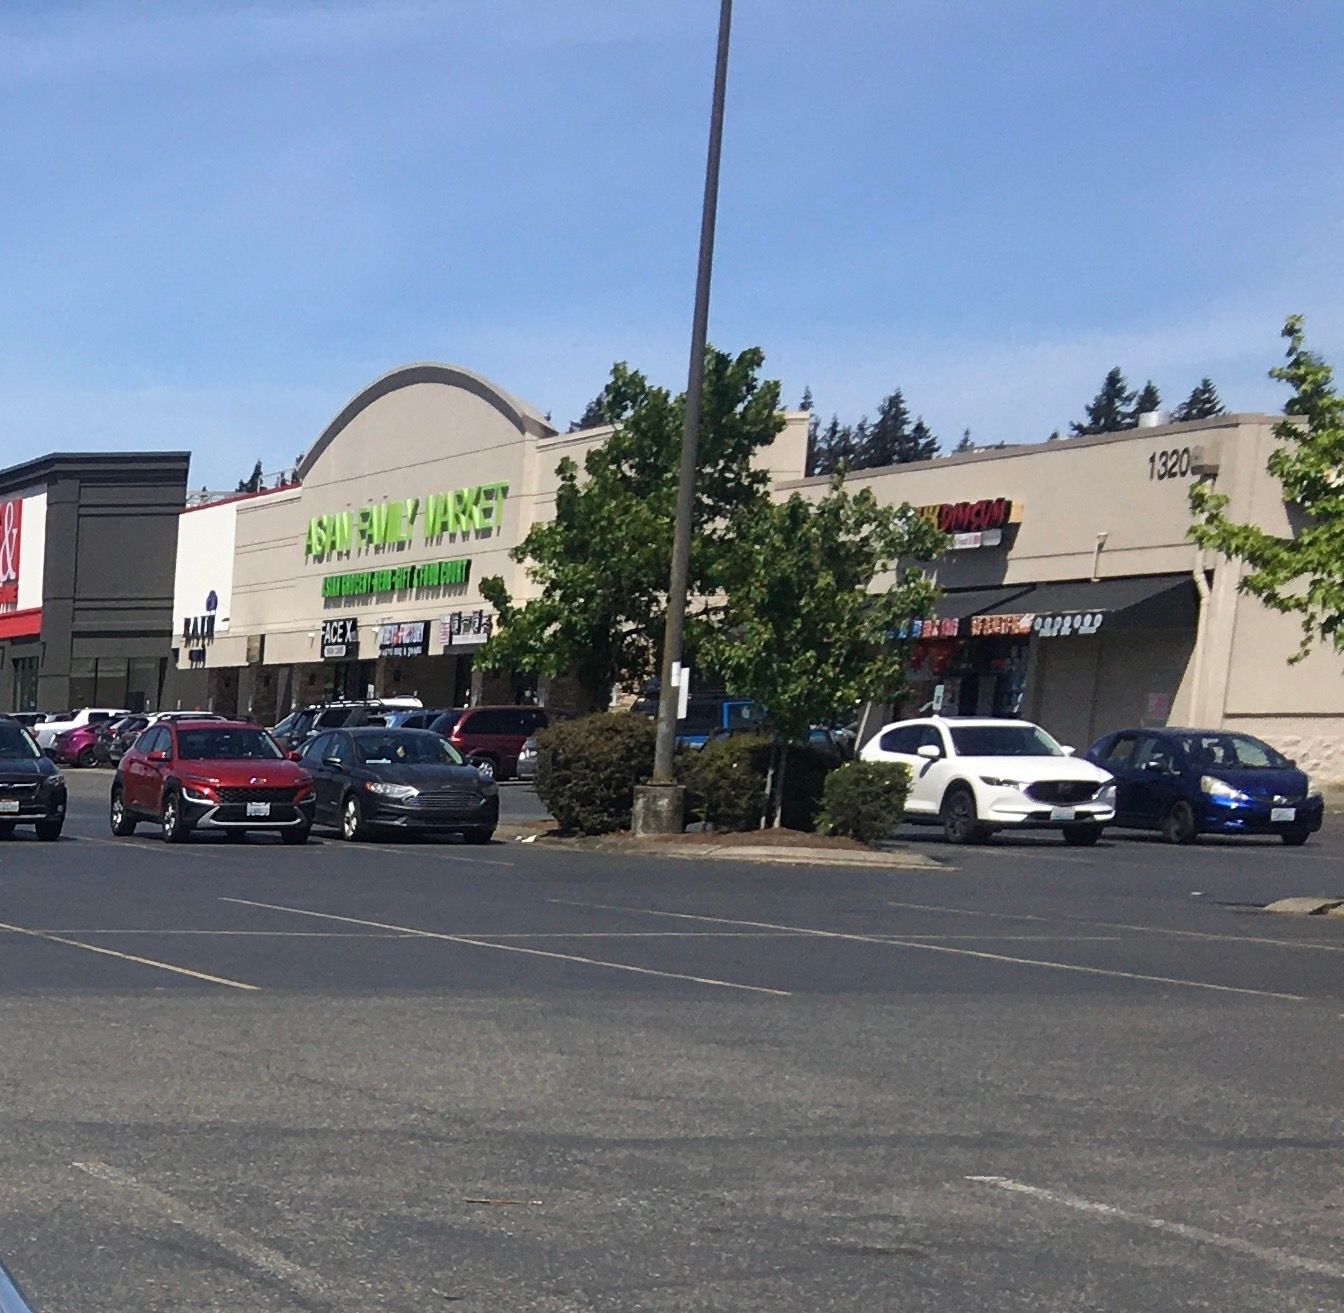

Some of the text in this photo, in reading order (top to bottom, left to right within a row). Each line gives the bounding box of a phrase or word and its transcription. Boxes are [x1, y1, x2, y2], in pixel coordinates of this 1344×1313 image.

[305, 480, 509, 555] ASIAN FAMILY MARKET
[321, 621, 344, 644] FACE
